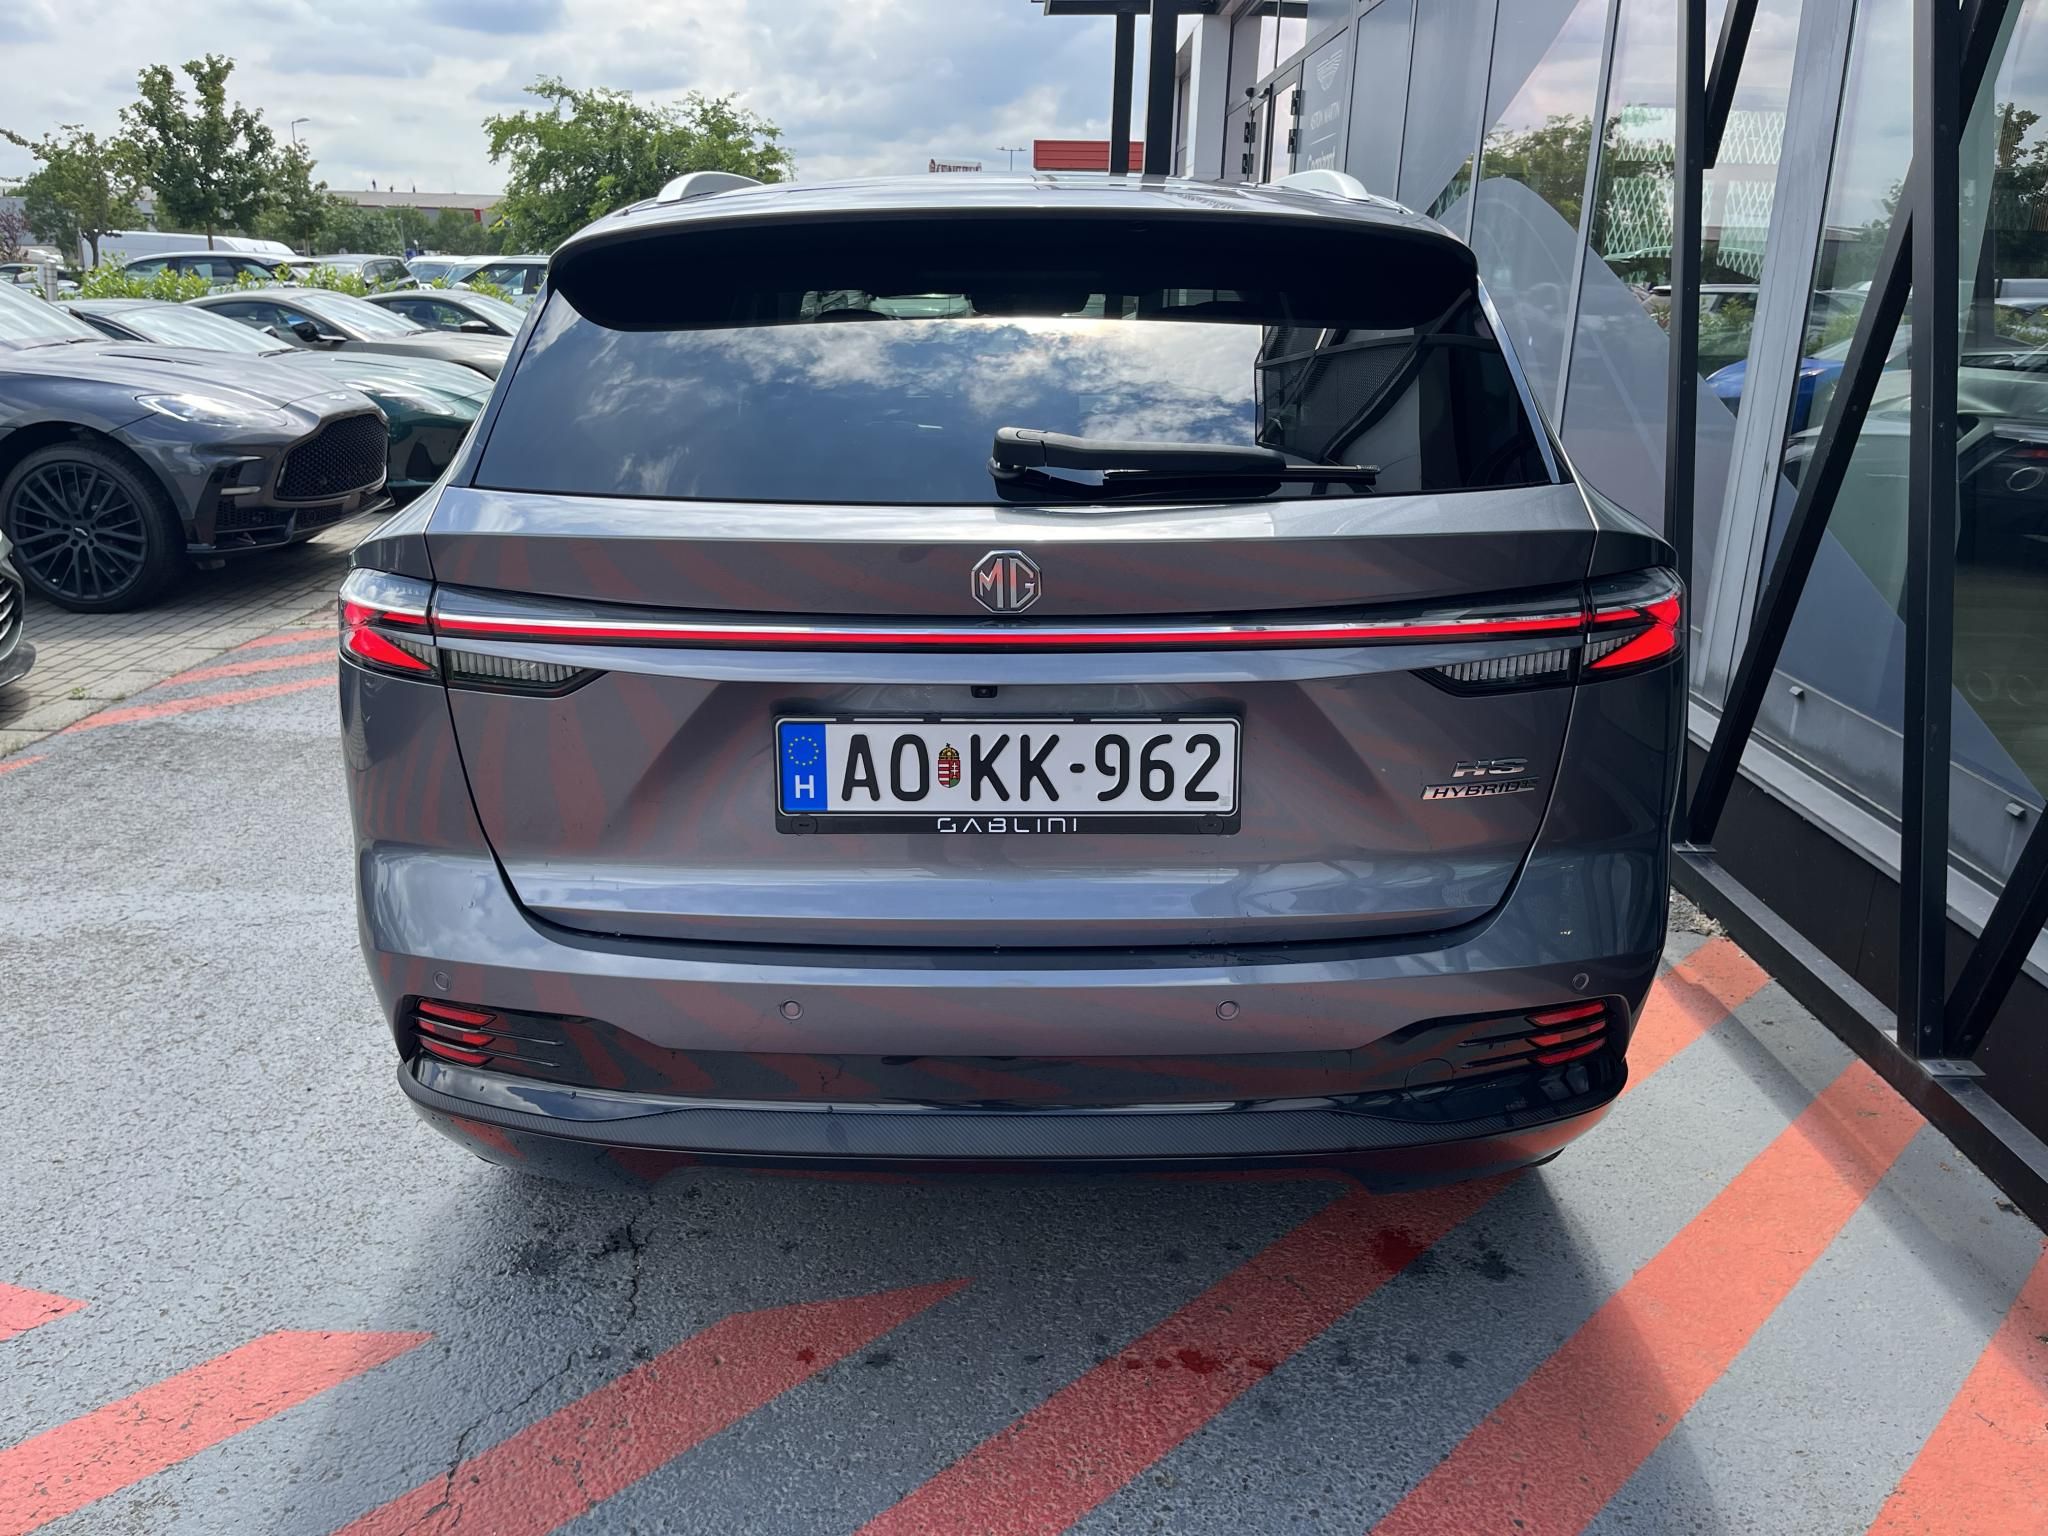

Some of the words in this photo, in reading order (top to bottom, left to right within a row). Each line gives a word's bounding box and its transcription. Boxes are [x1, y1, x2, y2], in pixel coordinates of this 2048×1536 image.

[979, 558, 1035, 609] MG
[841, 734, 930, 801] AO
[970, 734, 1221, 801] KK-962
[1452, 757, 1528, 778] HS
[794, 775, 815, 799] H
[937, 817, 1077, 833] GABLINI
